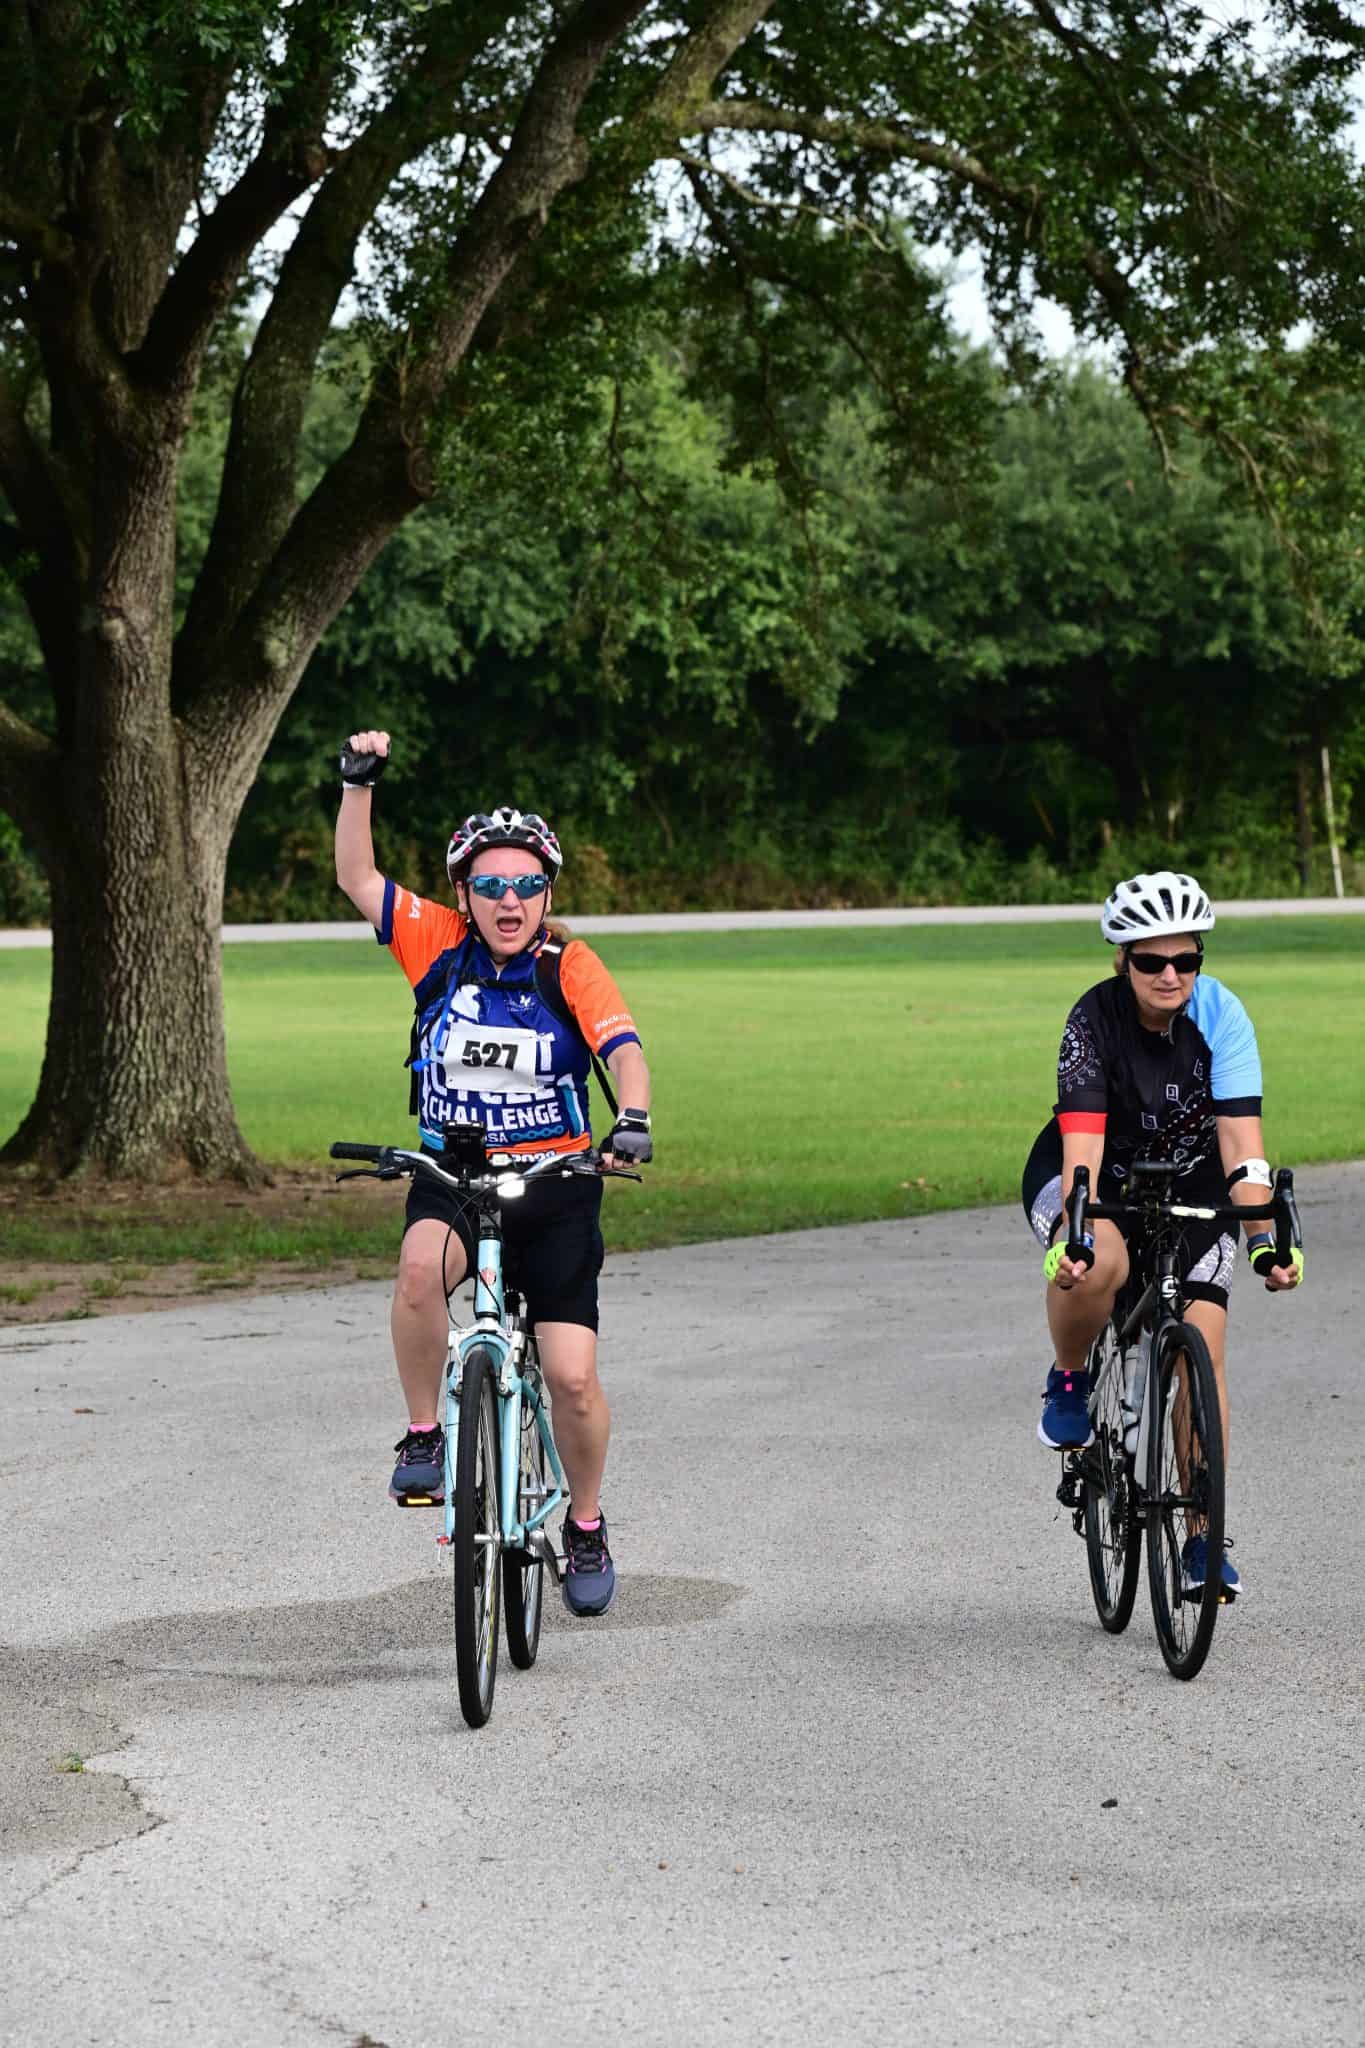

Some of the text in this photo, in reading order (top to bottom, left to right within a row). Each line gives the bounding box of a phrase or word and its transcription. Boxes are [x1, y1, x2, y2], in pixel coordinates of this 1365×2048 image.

[461, 1039, 519, 1071] 527
[429, 1095, 562, 1131] CHALLENGE
[485, 1132, 509, 1143] SA
